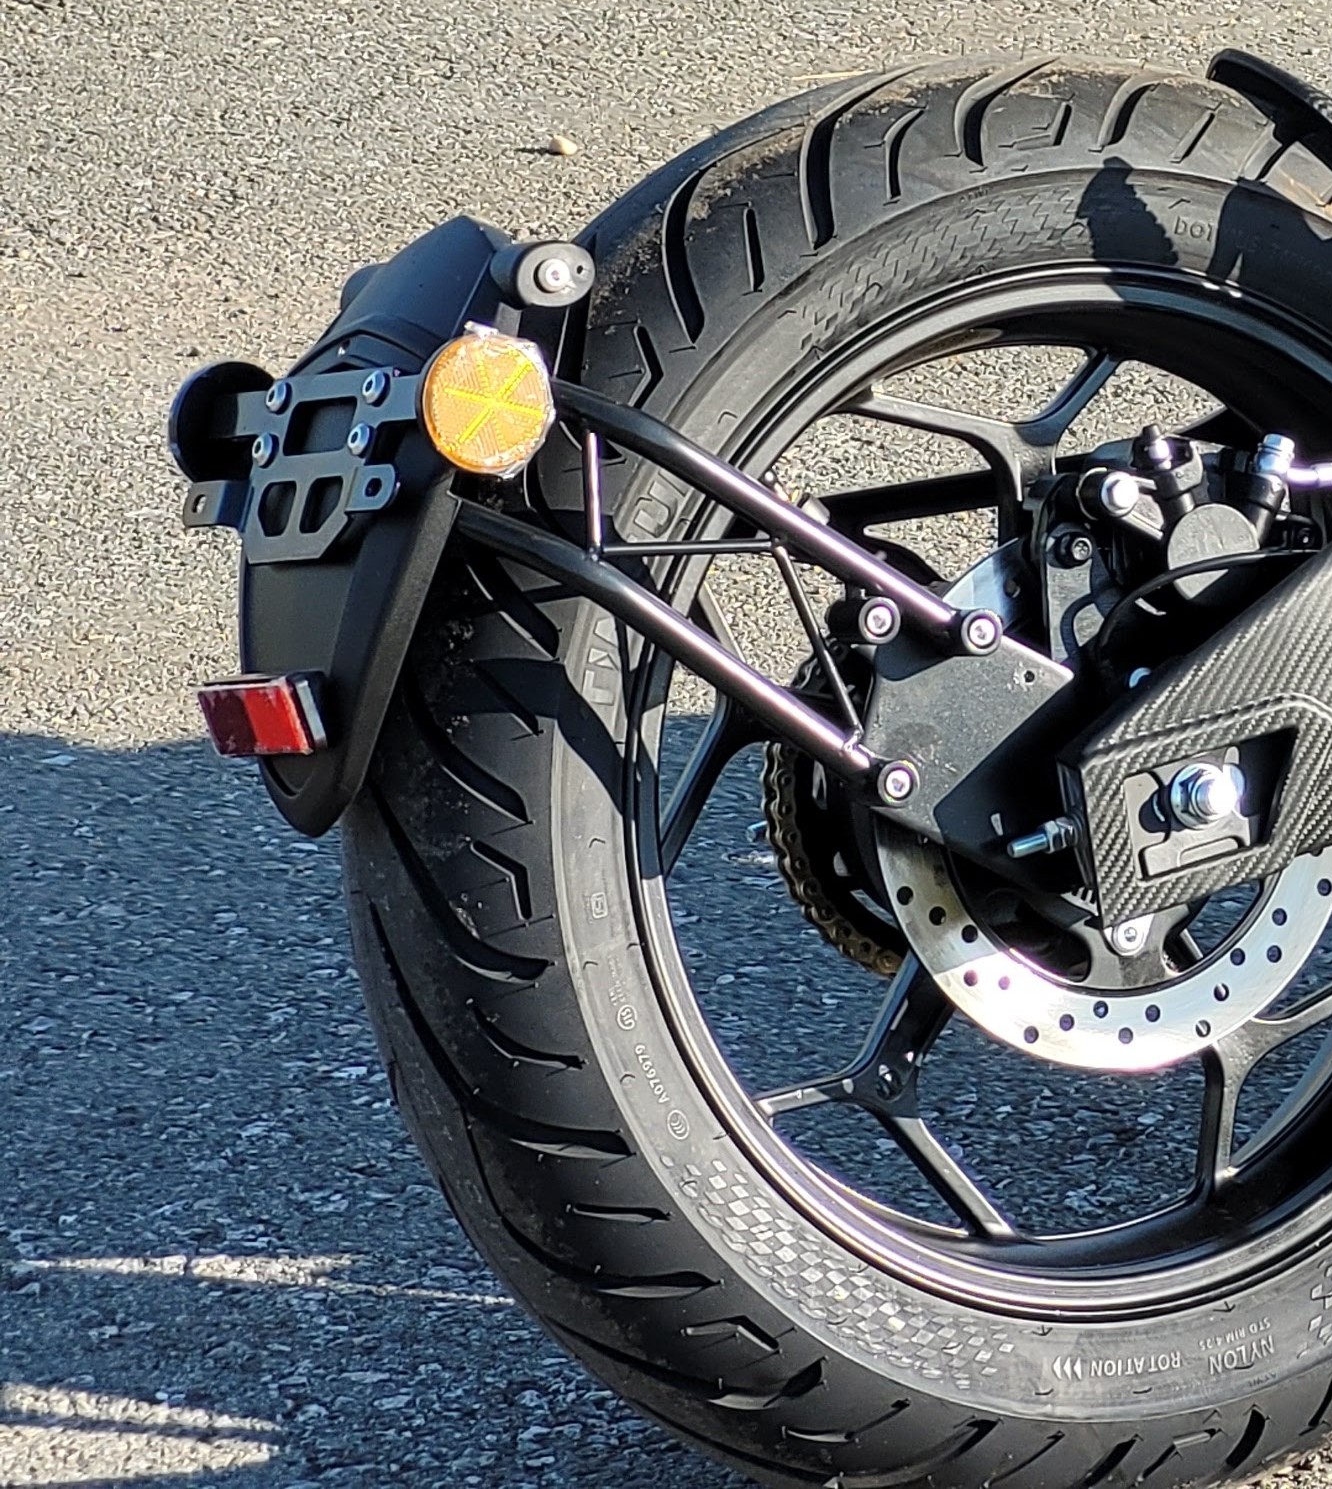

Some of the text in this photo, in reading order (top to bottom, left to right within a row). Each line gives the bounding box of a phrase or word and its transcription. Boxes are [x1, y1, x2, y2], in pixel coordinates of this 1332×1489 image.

[1249, 1317, 1271, 1334] STD
[1090, 1351, 1182, 1377] ROTATION
[1209, 1334, 1275, 1375] NYLON
